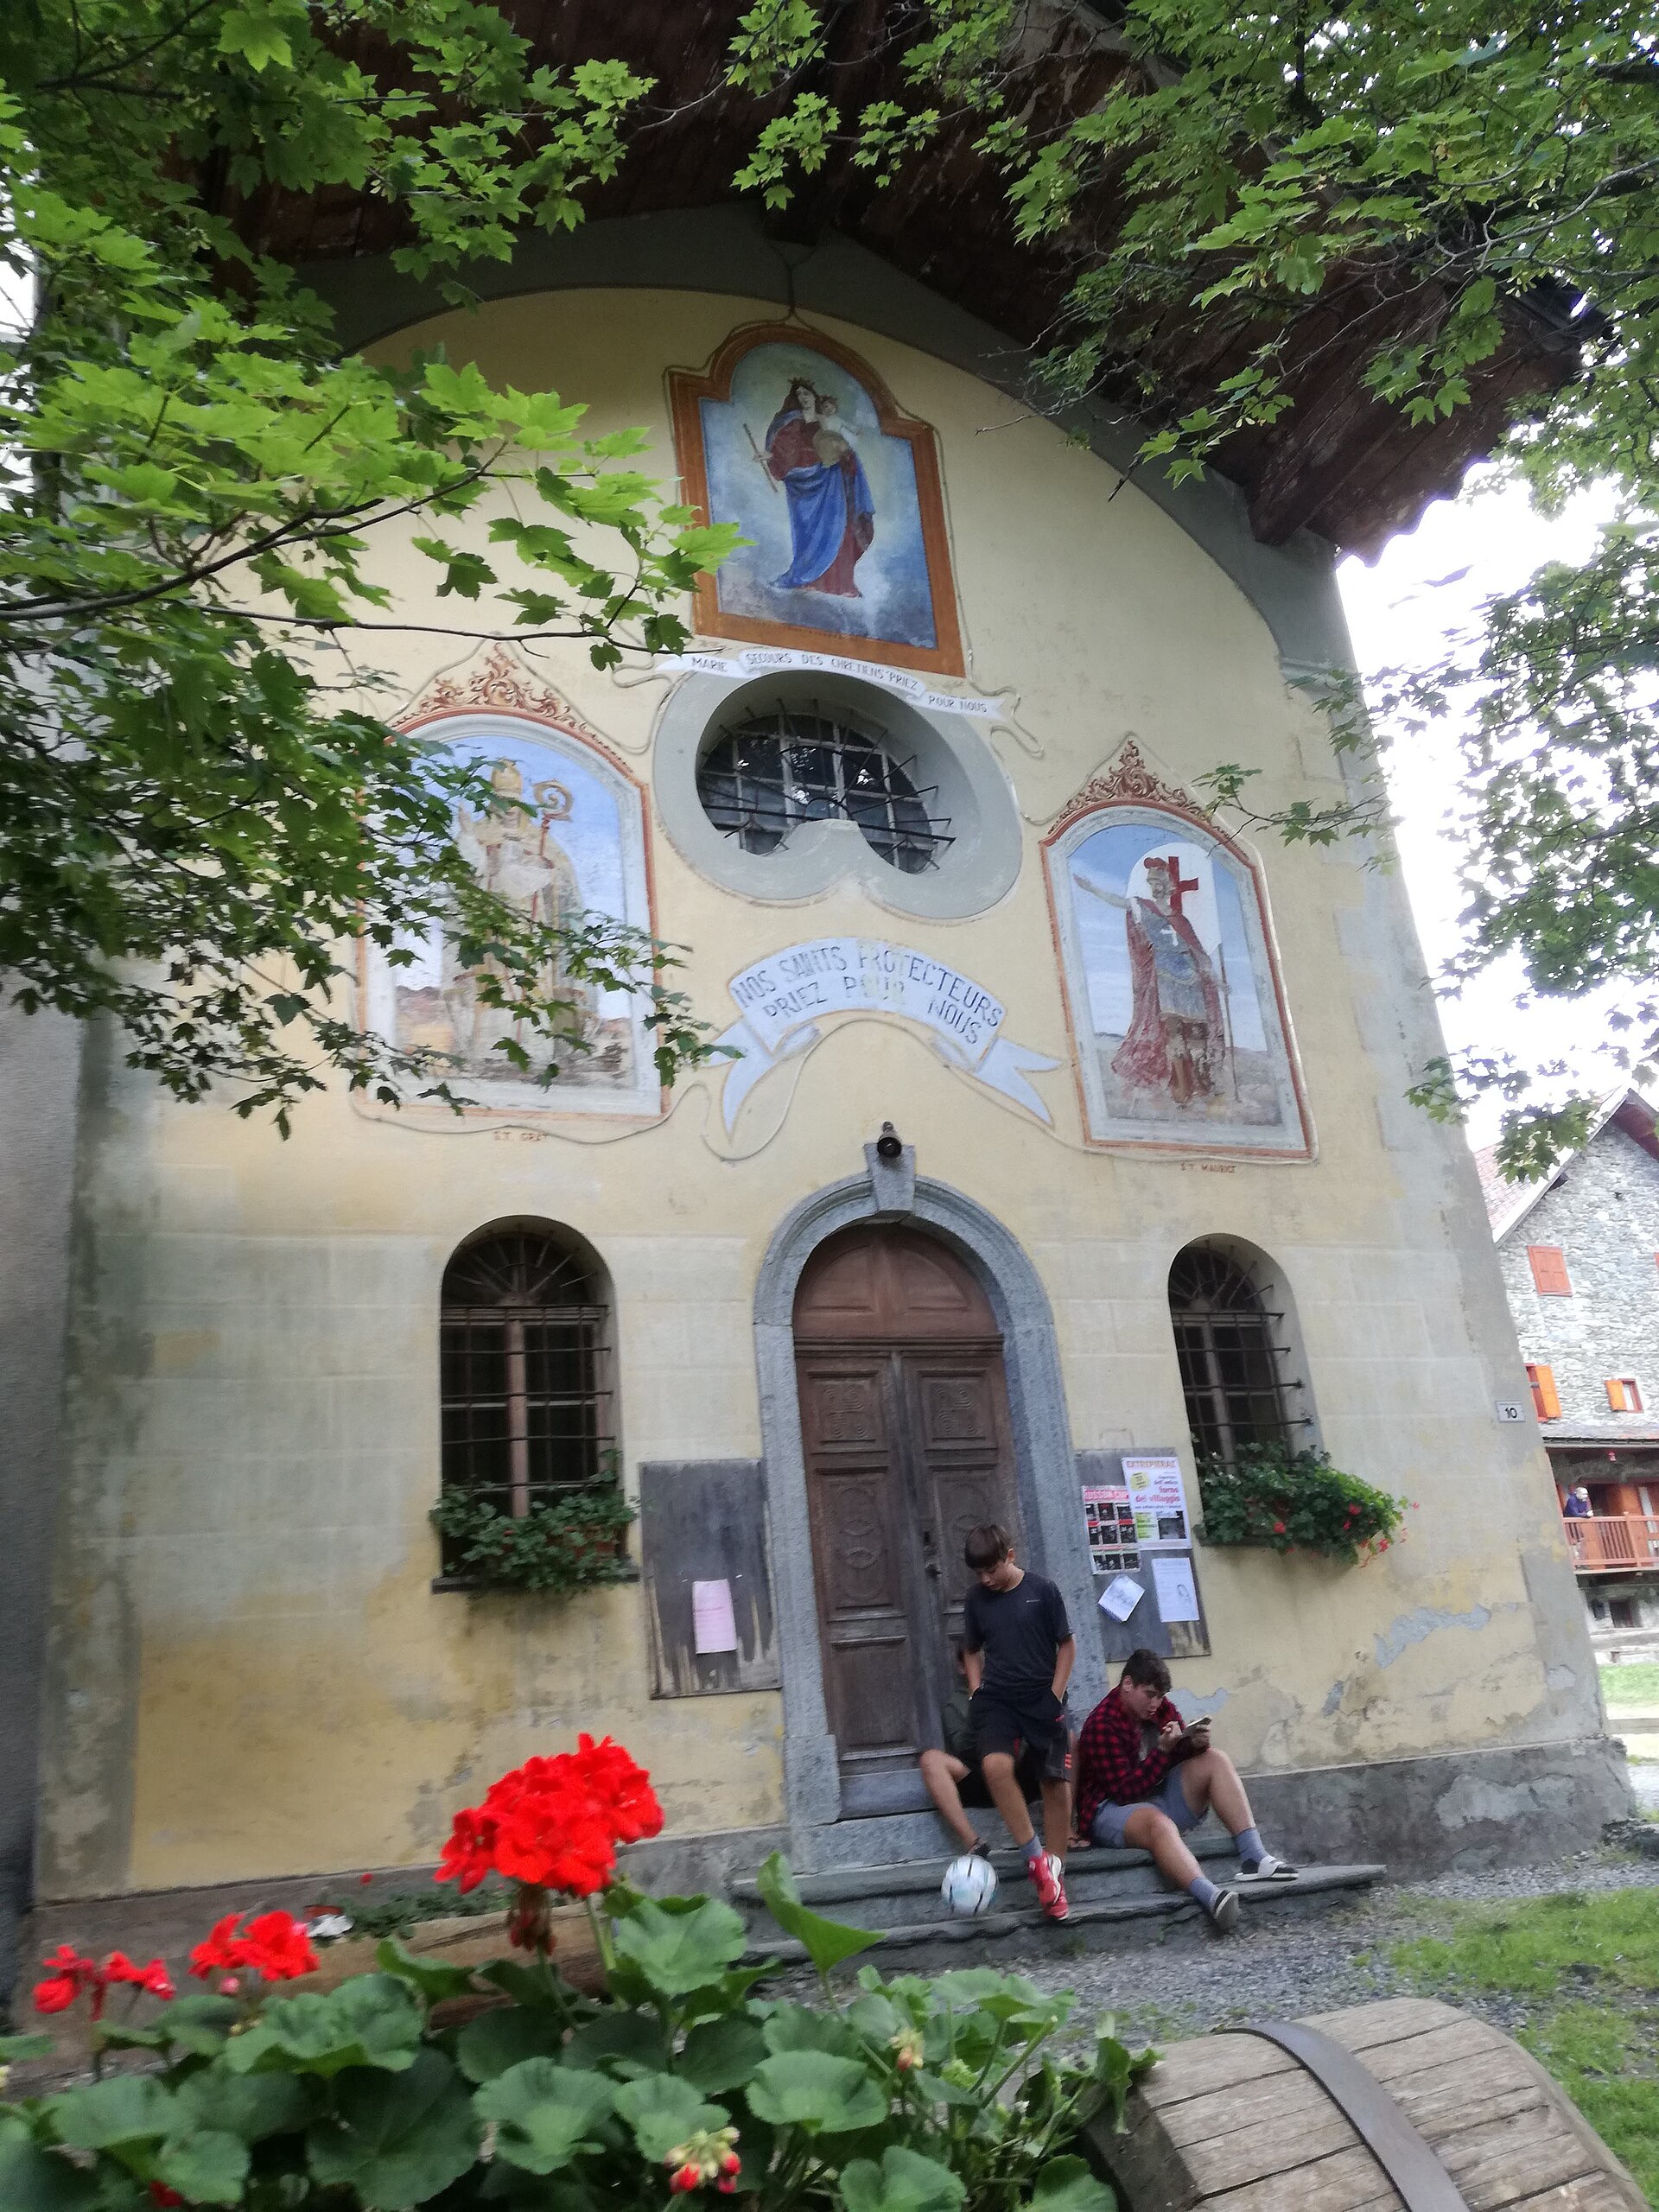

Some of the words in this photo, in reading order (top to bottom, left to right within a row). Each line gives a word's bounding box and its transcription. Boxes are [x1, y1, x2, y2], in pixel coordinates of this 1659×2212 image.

[691, 656, 728, 672] MARIE
[746, 652, 792, 665] SECOURS
[802, 654, 823, 665] DES
[928, 695, 955, 708] POUR
[960, 699, 988, 713] NOUS
[731, 969, 776, 1008] NOS
[762, 981, 828, 1019] PRIEZ
[928, 999, 982, 1045] NOUS
[1504, 1407, 1518, 1419] 10
